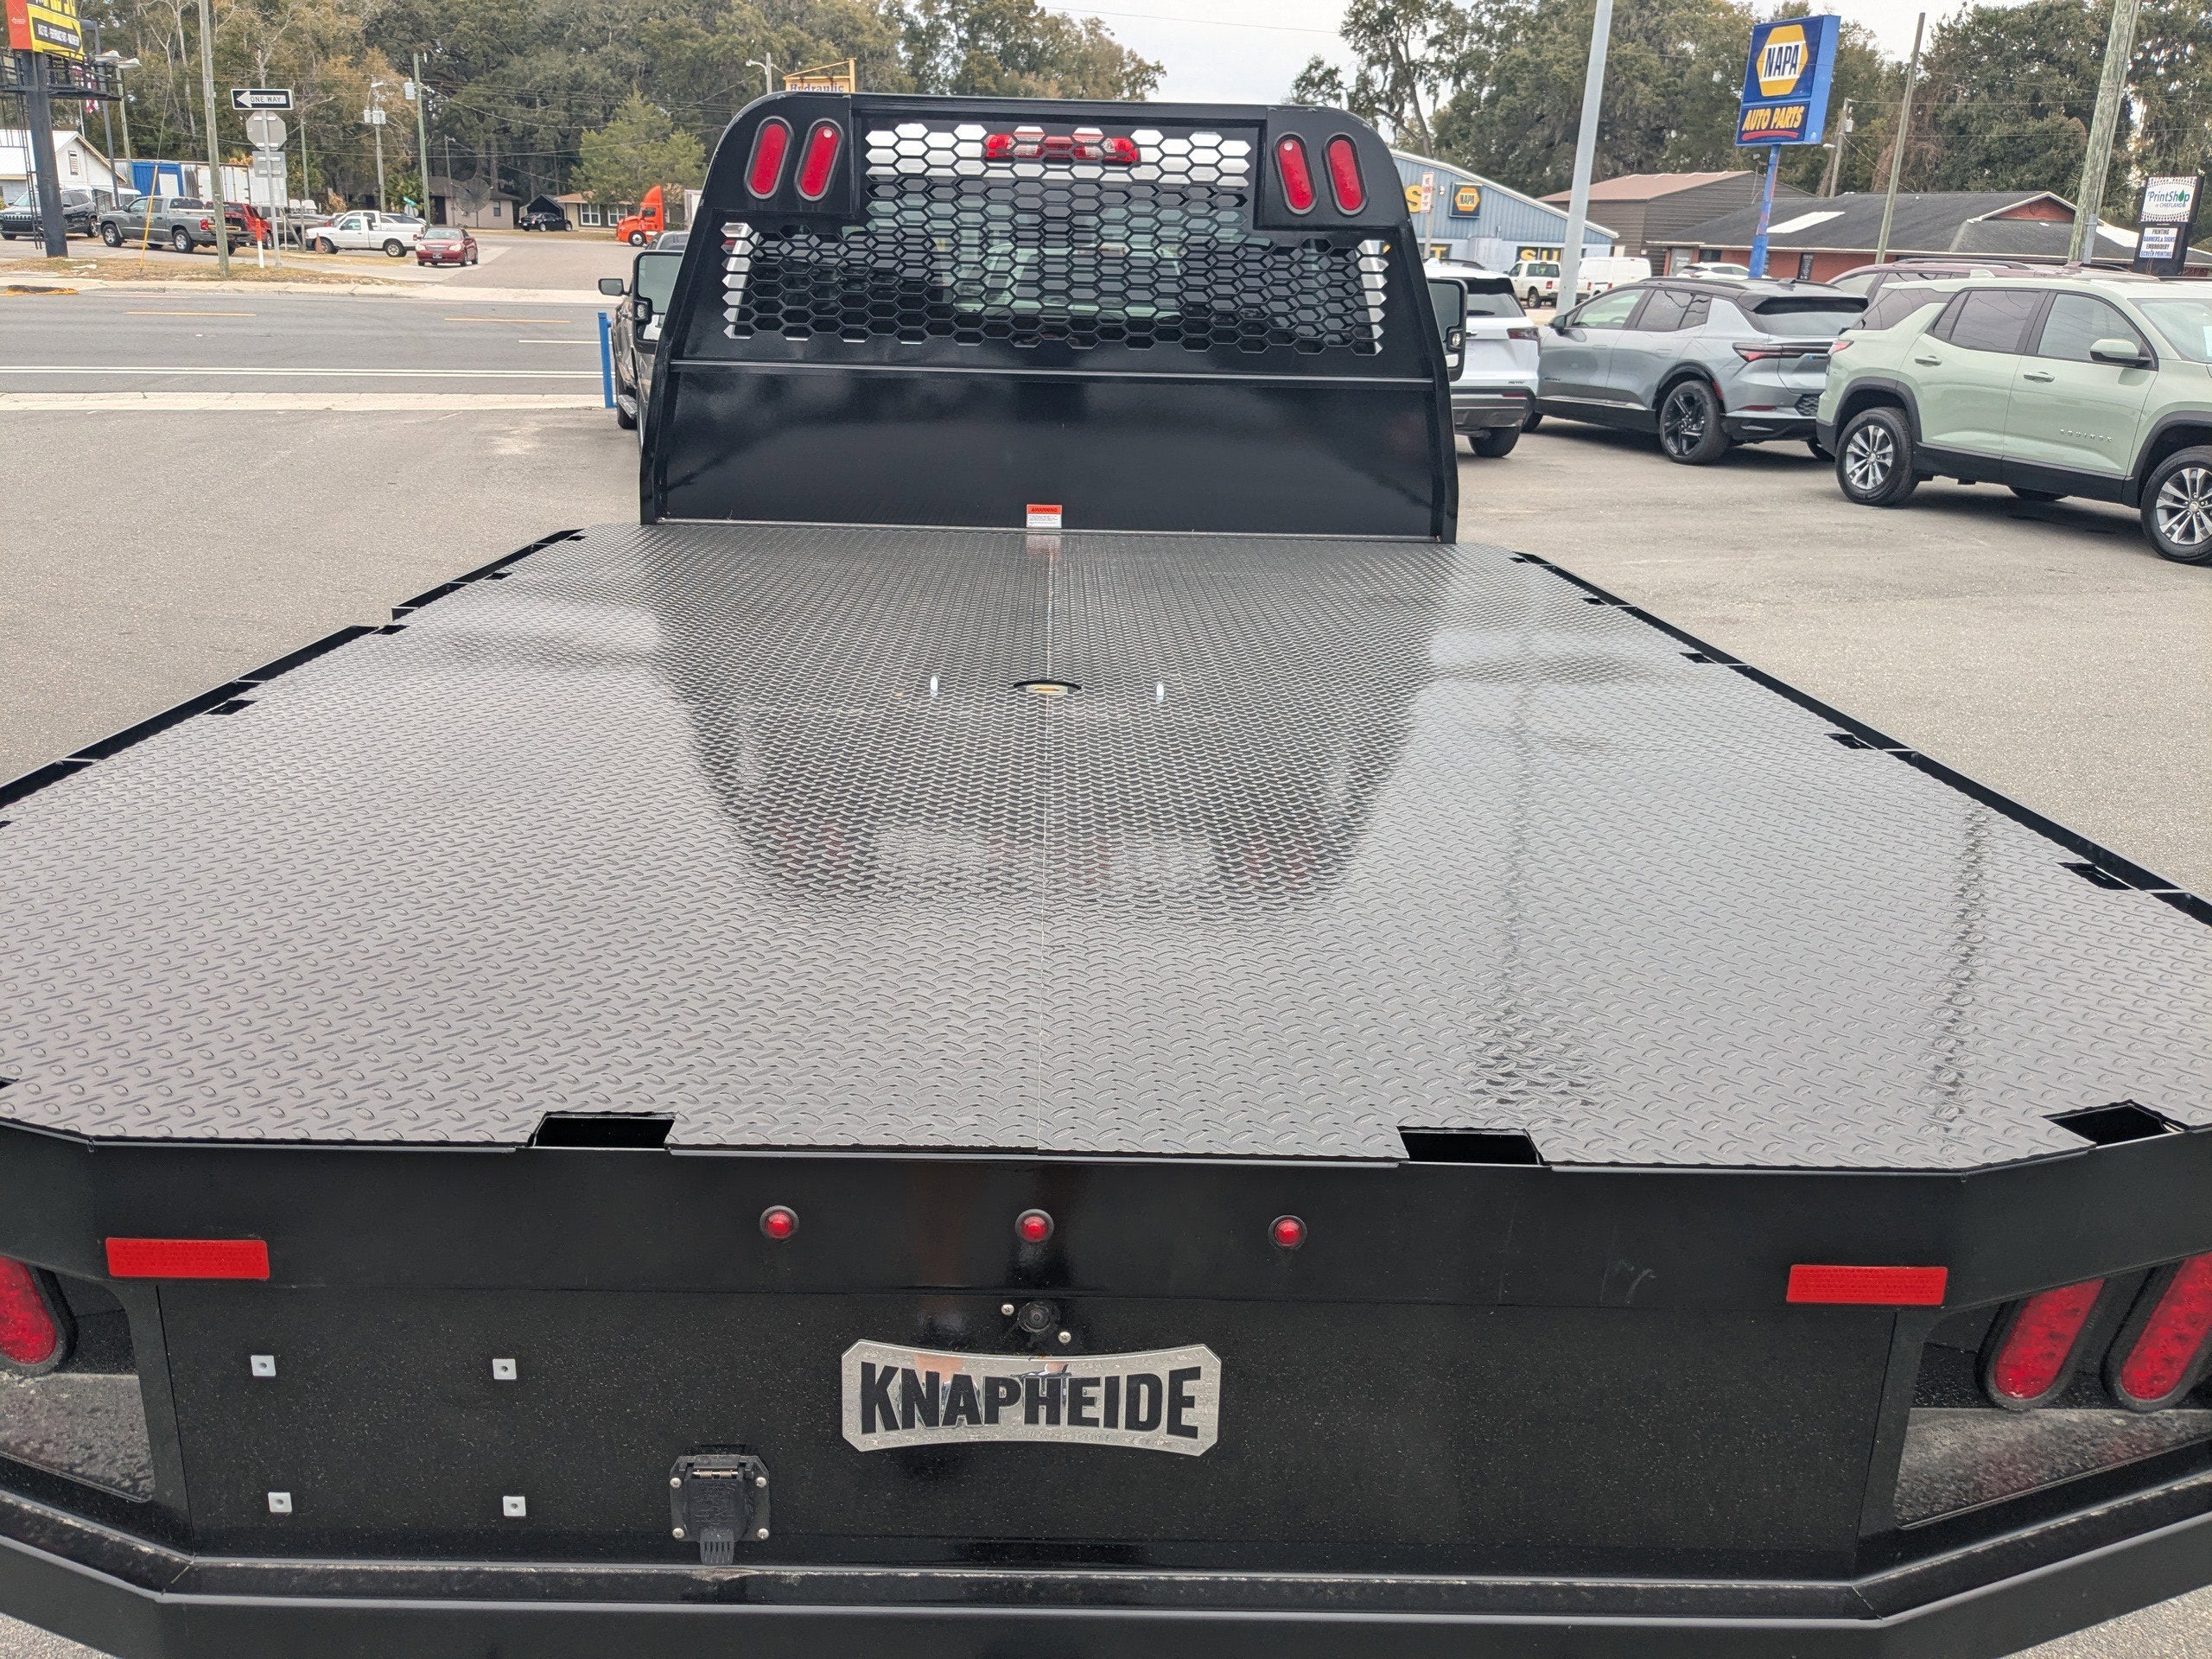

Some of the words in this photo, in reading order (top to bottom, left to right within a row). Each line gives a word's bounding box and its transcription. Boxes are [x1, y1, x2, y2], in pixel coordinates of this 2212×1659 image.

[1764, 45, 1799, 77] NAPA
[790, 82, 844, 92] Hydraulic
[1742, 108, 1771, 130] AUTO
[1770, 106, 1805, 129] PARTS
[1459, 194, 1475, 206] NAPA
[861, 1361, 1201, 1440] KNAPHEIDE
